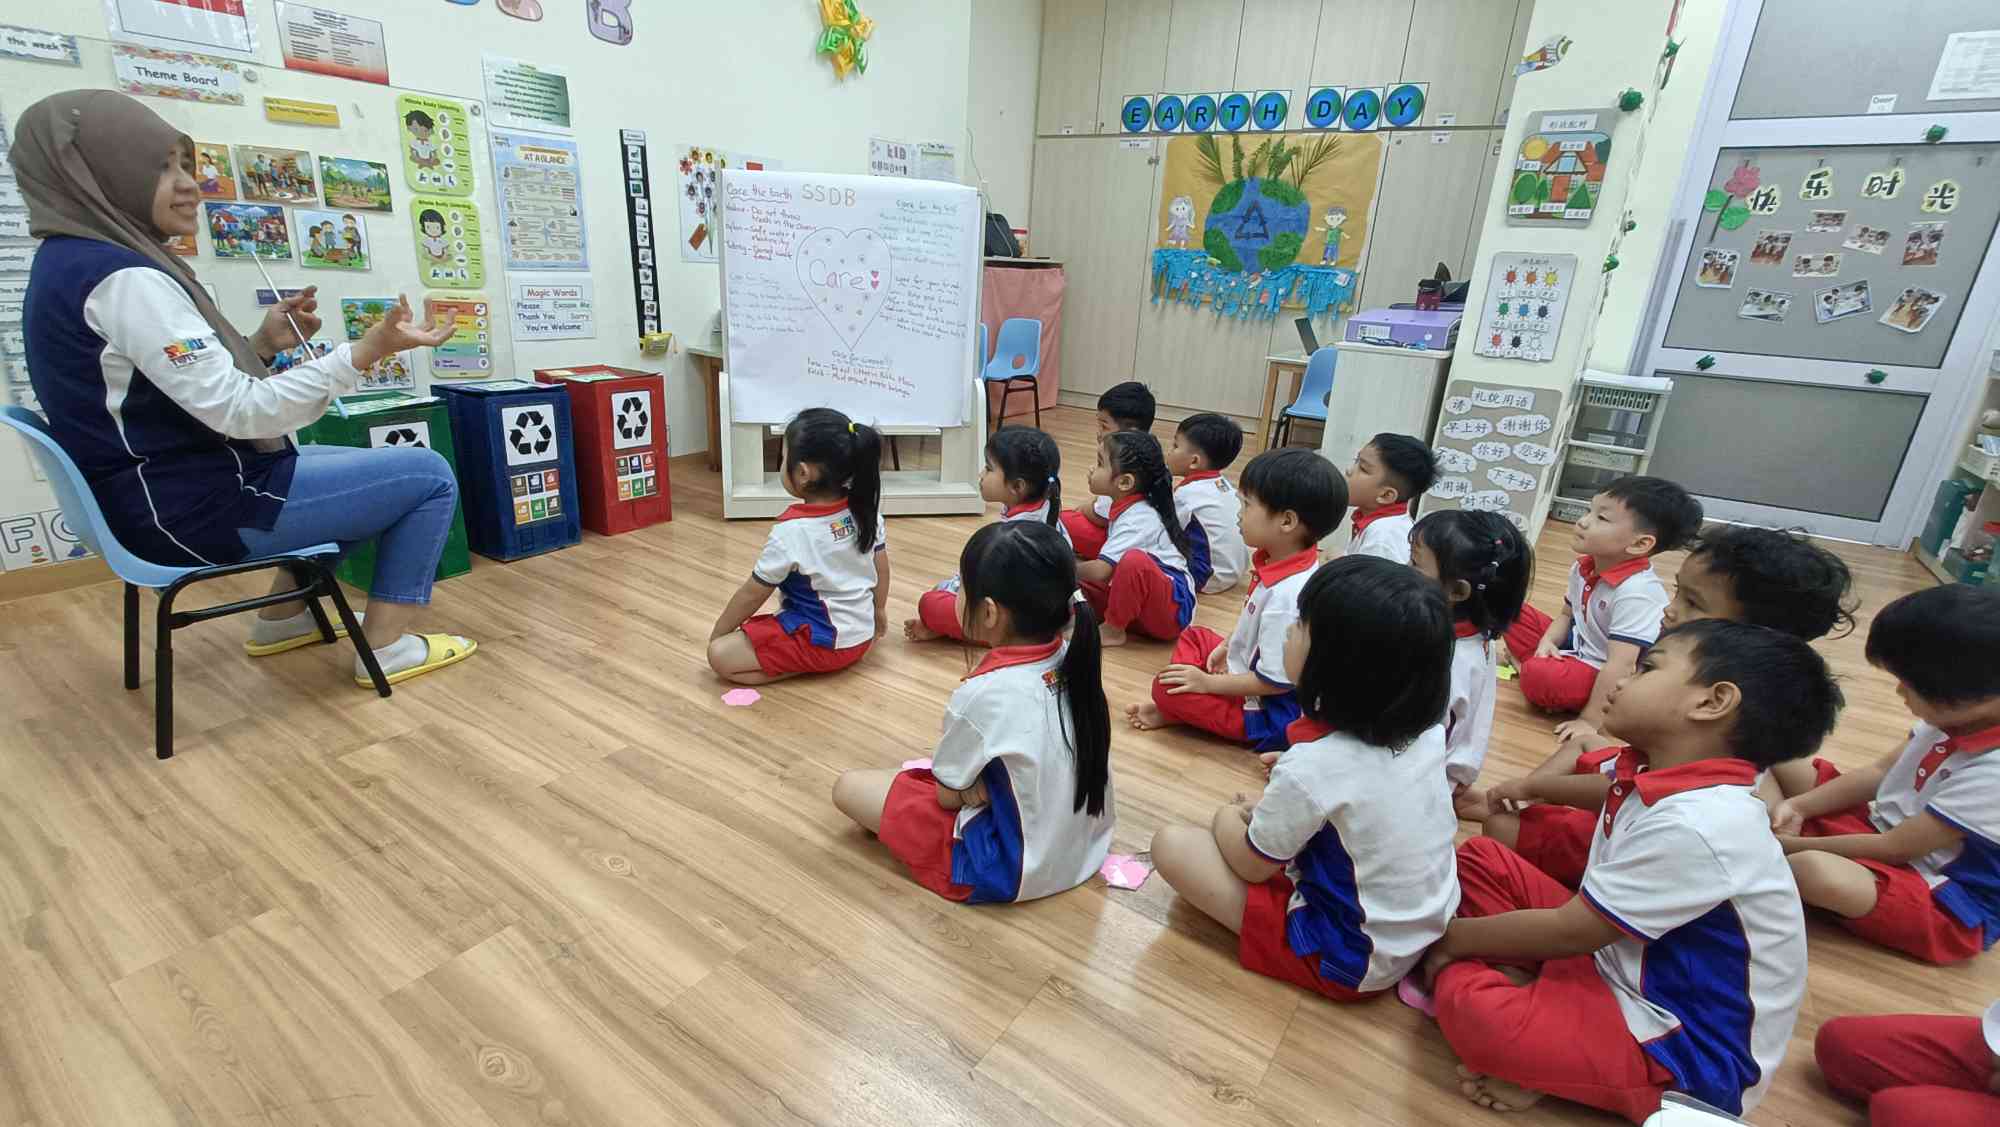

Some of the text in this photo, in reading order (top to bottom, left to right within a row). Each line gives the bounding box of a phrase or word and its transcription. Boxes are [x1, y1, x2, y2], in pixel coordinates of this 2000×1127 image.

[7, 36, 27, 47] the
[135, 66, 219, 87] Theme Board
[1129, 103, 1279, 124] EARTH
[1316, 97, 1413, 121] DAY
[801, 183, 856, 208] SSDB
[808, 258, 866, 291] Care
[527, 287, 577, 300] Magic Words
[516, 301, 541, 310] Please
[517, 311, 591, 321] Thank You Sorry
[526, 321, 582, 332] You're Welcome
[1447, 422, 1488, 434] 早上好
[1503, 419, 1547, 433] 谢谢你
[1478, 444, 1505, 458] 你好
[1493, 469, 1533, 490] 下午好
